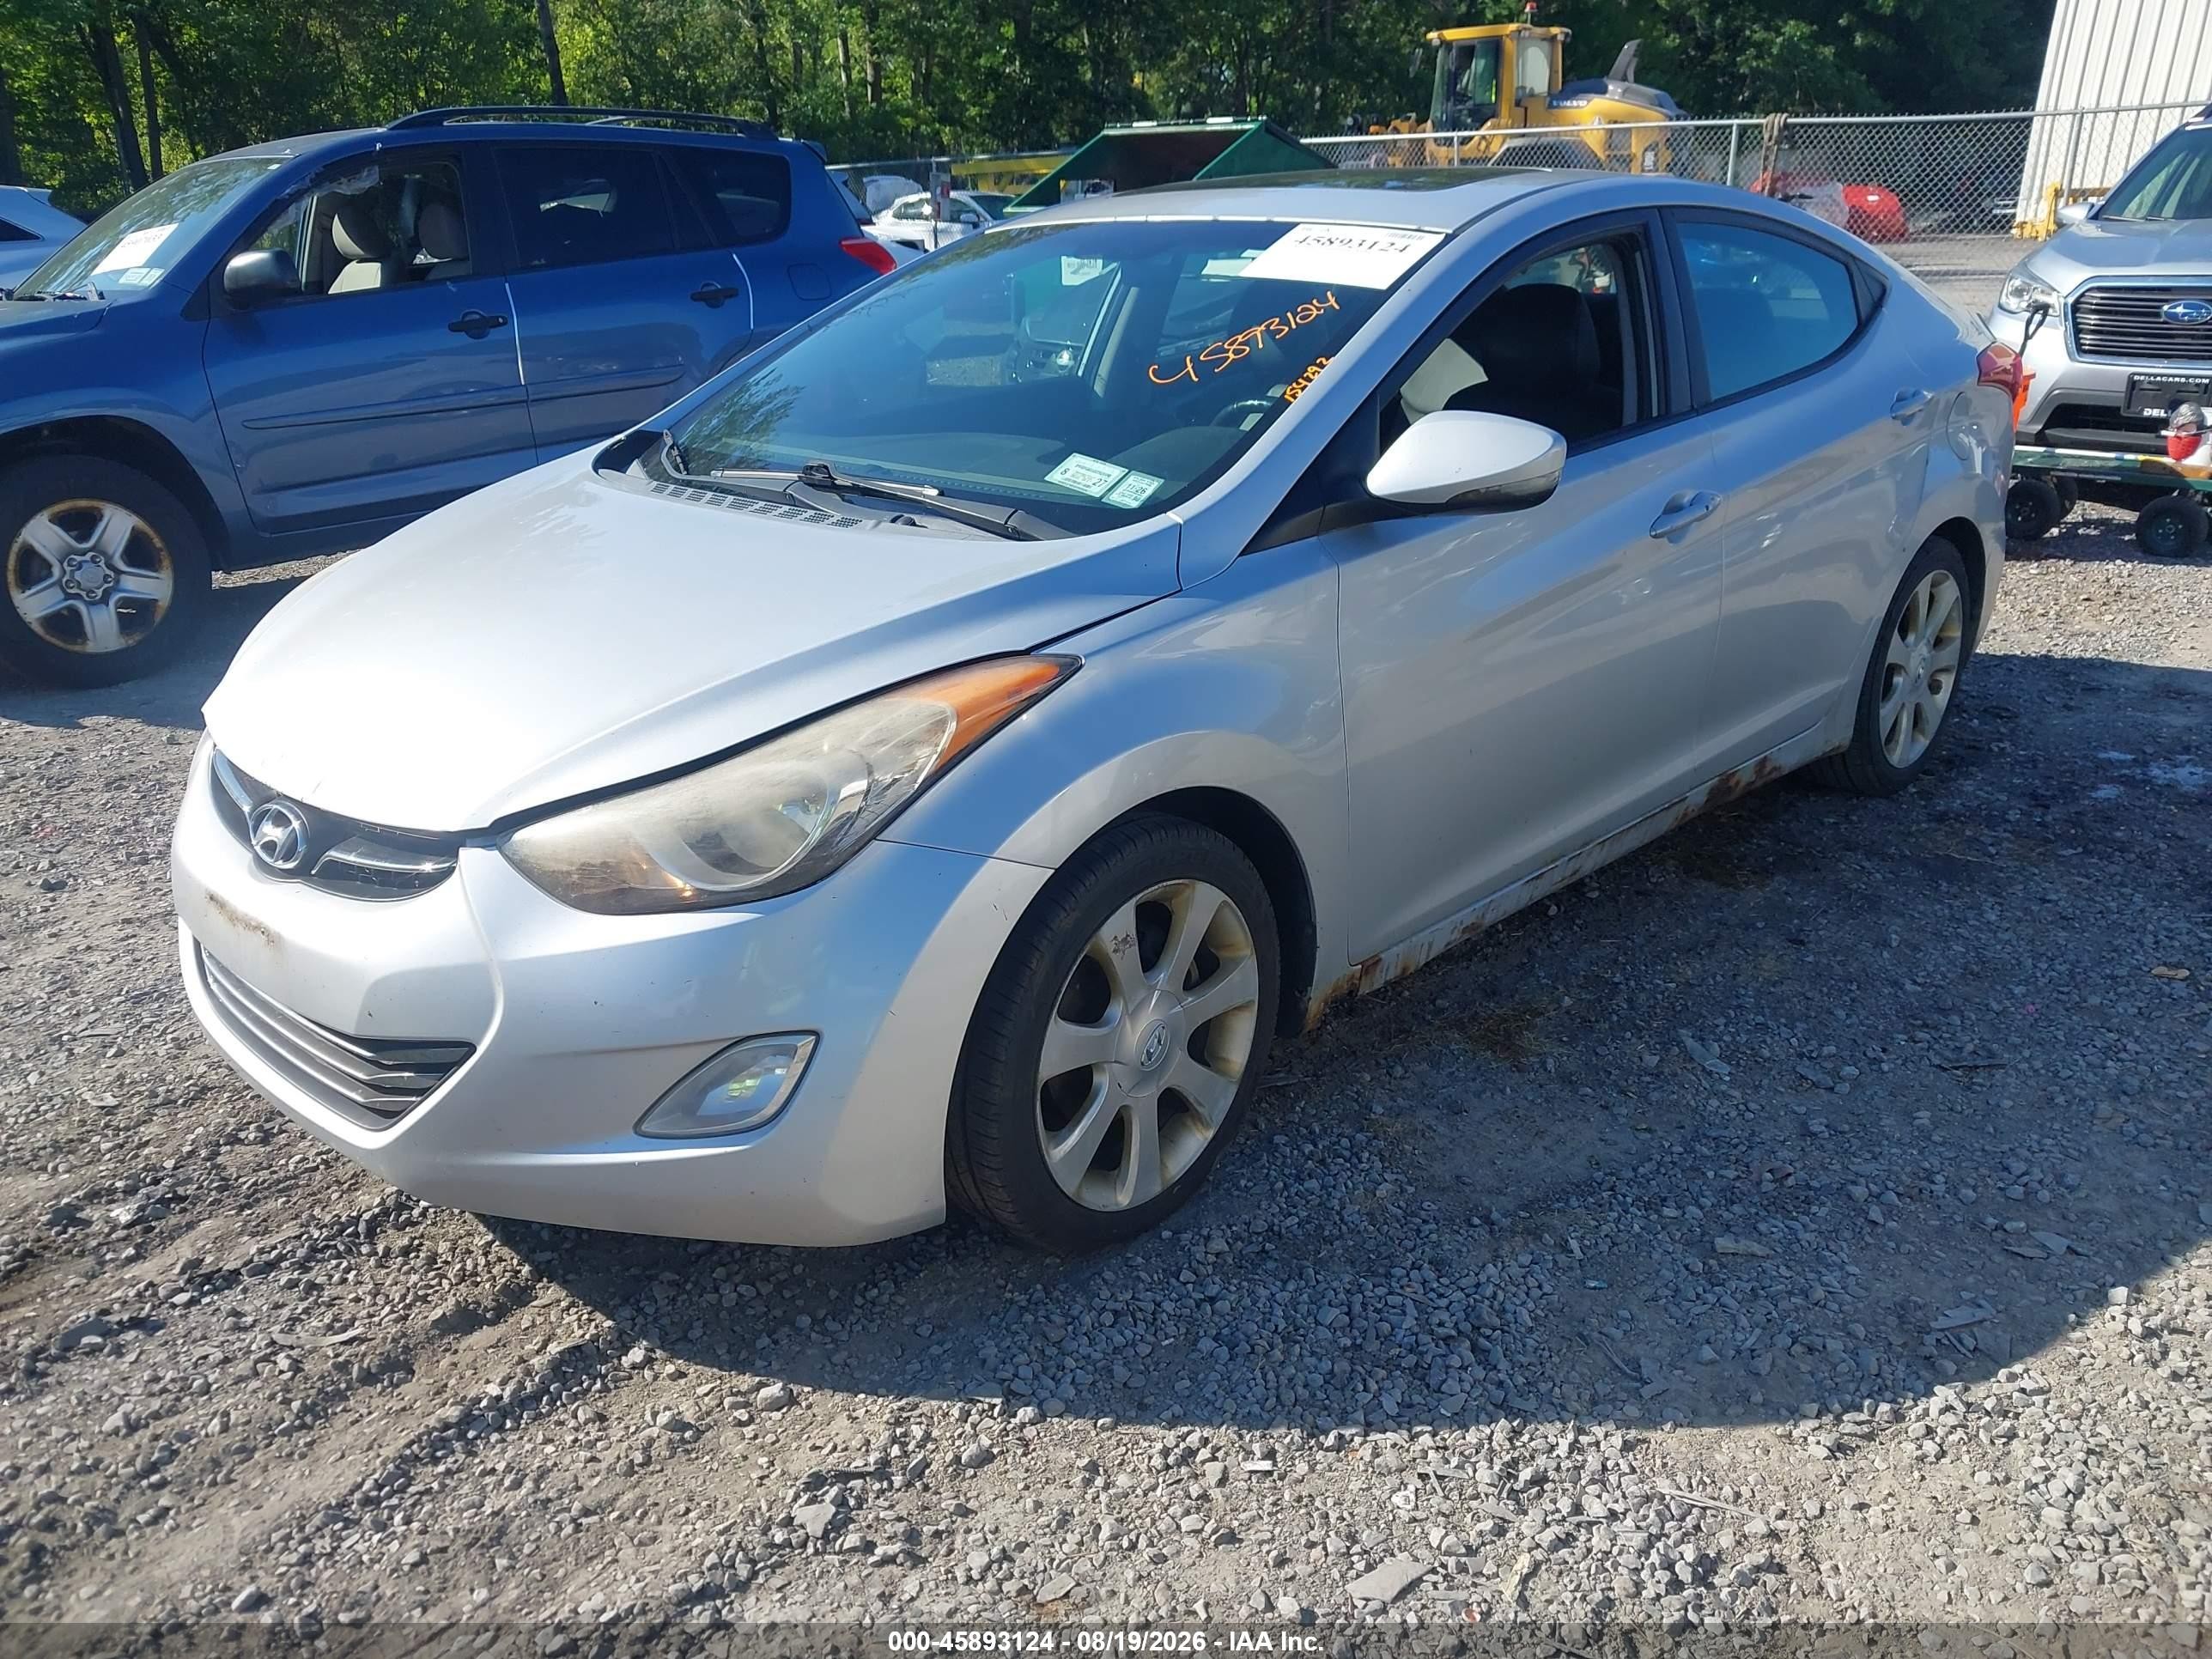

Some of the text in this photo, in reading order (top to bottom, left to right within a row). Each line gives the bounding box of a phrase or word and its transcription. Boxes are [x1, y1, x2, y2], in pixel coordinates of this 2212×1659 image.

[1294, 234, 1411, 252] 45893124
[1148, 290, 1340, 384] 45893124
[2133, 374, 2210, 384] DELLACARS.COM
[1091, 477, 1109, 488] 27
